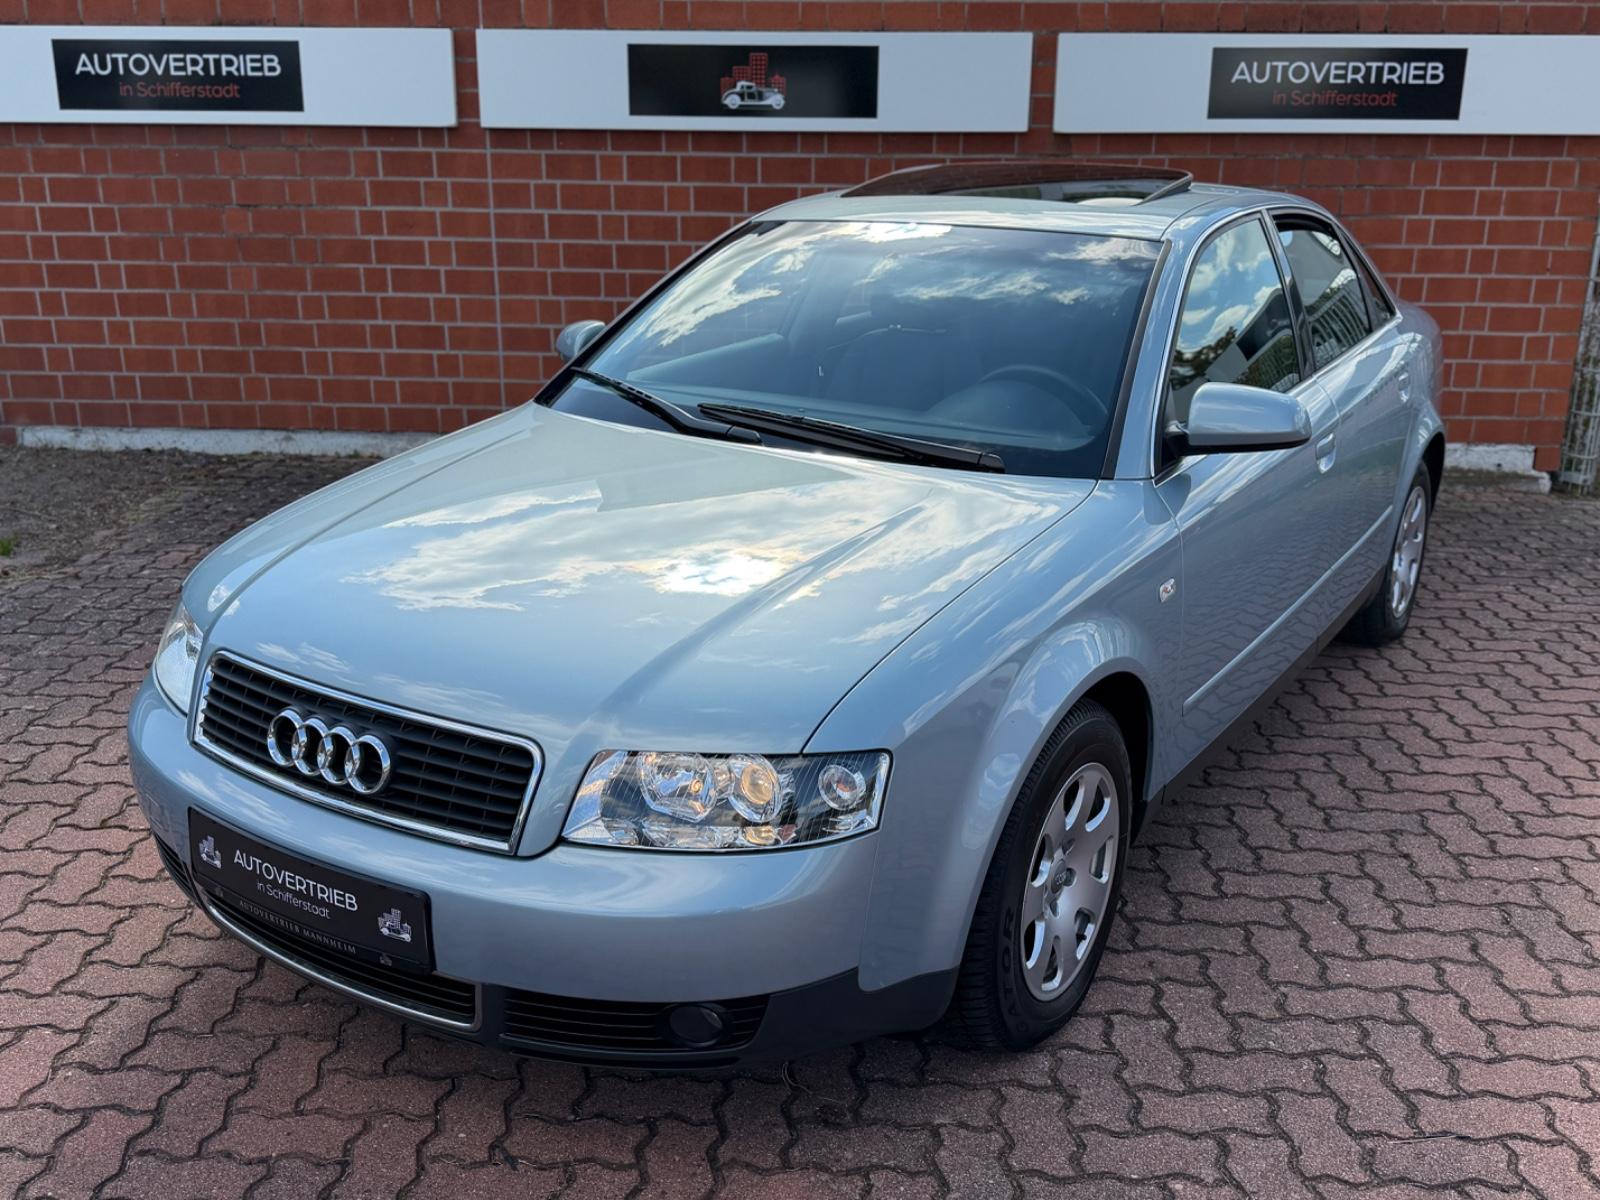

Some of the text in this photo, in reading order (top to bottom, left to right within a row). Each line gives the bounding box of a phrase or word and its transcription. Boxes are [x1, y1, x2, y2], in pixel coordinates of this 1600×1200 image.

[75, 53, 282, 77] AUTOVERTRIEB
[1231, 61, 1445, 85] AUTOVERTRIEB
[119, 82, 240, 98] in Schifferstadt
[1273, 89, 1398, 107] in Schifferstadt
[233, 849, 358, 912] AUTOVERTRIEB
[257, 880, 331, 919] in Schifferstadt
[303, 929, 356, 954] MANNHEIM
